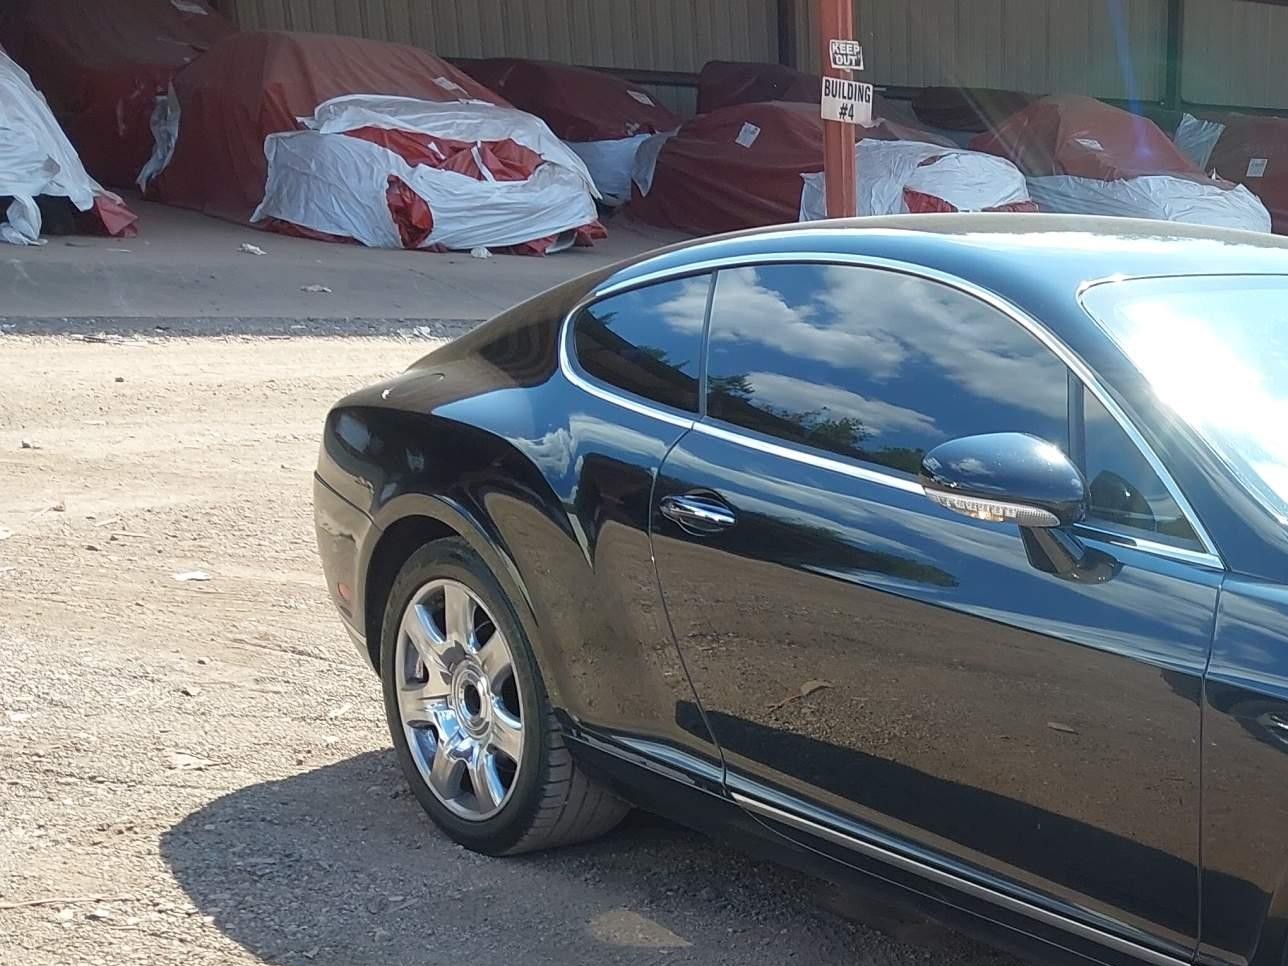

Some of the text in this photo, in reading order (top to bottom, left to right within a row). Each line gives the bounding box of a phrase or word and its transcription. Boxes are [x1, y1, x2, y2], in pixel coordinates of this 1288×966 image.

[832, 42, 860, 54] KEEP
[835, 54, 858, 65] OUT
[824, 79, 871, 103] BUILDING
[838, 103, 854, 121] #4
